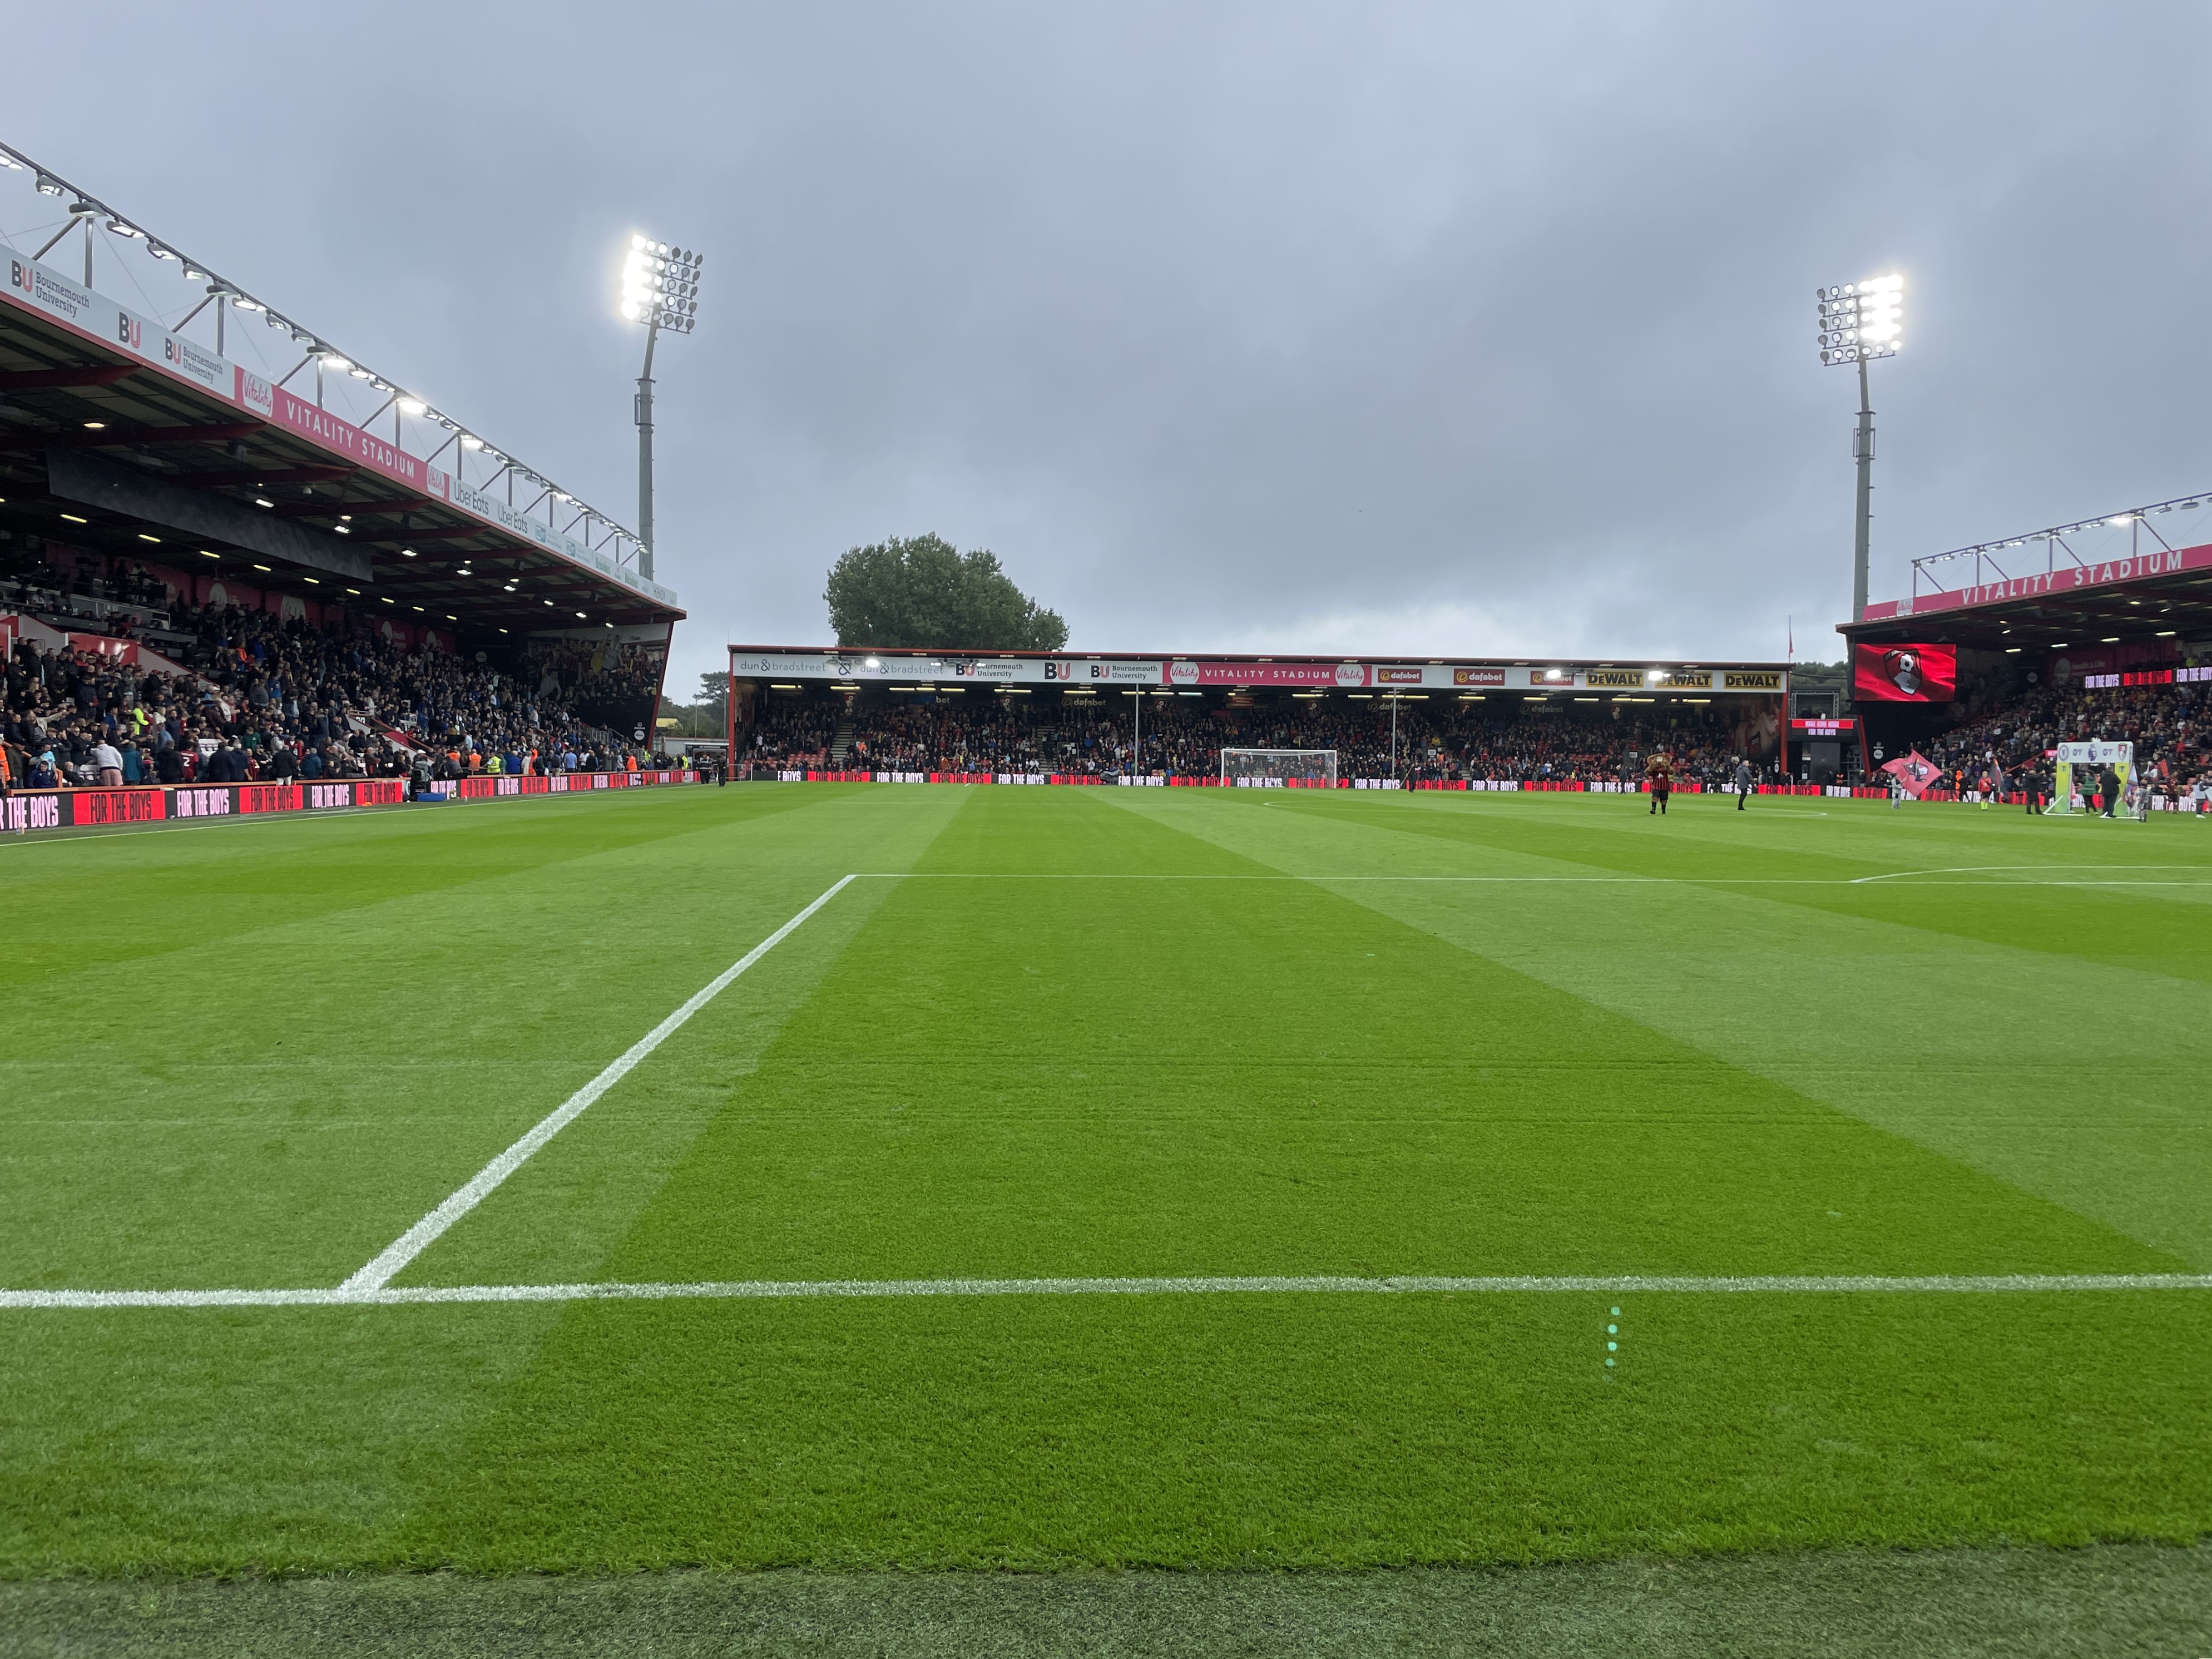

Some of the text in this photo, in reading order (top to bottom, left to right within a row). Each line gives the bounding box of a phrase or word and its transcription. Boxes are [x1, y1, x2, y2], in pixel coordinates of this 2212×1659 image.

[12, 259, 33, 293] BU
[36, 271, 90, 309] Bournemouth
[36, 286, 77, 318] University
[119, 311, 141, 349] BU
[165, 337, 181, 364] BU
[183, 346, 224, 375] Bournemouth
[183, 358, 214, 384] University
[244, 373, 271, 416] Vitality
[286, 399, 415, 479] VITALITY STADIUM
[454, 481, 489, 515] Uber Eats
[498, 503, 528, 534] Uber Eats
[1962, 551, 2182, 604] VITALITY STADIUM
[1045, 662, 1070, 680] BU
[1091, 665, 1110, 679] BU
[1171, 666, 1198, 680] Vitality
[1205, 669, 1330, 679] VITALITY STADIUM
[1337, 668, 1363, 682] Vitality
[1390, 671, 1419, 680] dafabet
[1468, 672, 1502, 682] dafabet
[2176, 668, 2187, 682] FOR
[2189, 667, 2199, 681] THE
[2086, 675, 2095, 689] FOR
[2095, 675, 2105, 687] THE
[1073, 697, 1107, 707] dafabet
[1379, 702, 1412, 711] dafbet
[183, 757, 190, 766] 2
[877, 773, 924, 783] FOR THE BOYS
[998, 774, 1045, 785] FOR THE BOYS
[1086, 775, 1101, 785] BOY
[1118, 776, 1164, 786] FOR THE BOYS
[1237, 777, 1283, 788] FOR THE BOYS
[1355, 779, 1400, 790] FOR THE BOYS
[1416, 780, 1426, 791] OR
[1473, 780, 1518, 791] FOR THE BOYS
[1590, 781, 1603, 793] FOR
[1605, 781, 1617, 793] THE
[1734, 784, 1752, 794] BS
[176, 789, 229, 817] FOR THE BOYS
[265, 788, 275, 810] THE
[278, 787, 294, 810] BOYS
[311, 784, 349, 808] FOR THE BOYS
[91, 792, 151, 823] FOR THE BOYS
[2151, 795, 2164, 810] FOR
[2178, 796, 2197, 812] BOYS
[7, 797, 27, 829] THE
[30, 795, 58, 828] BOYS
